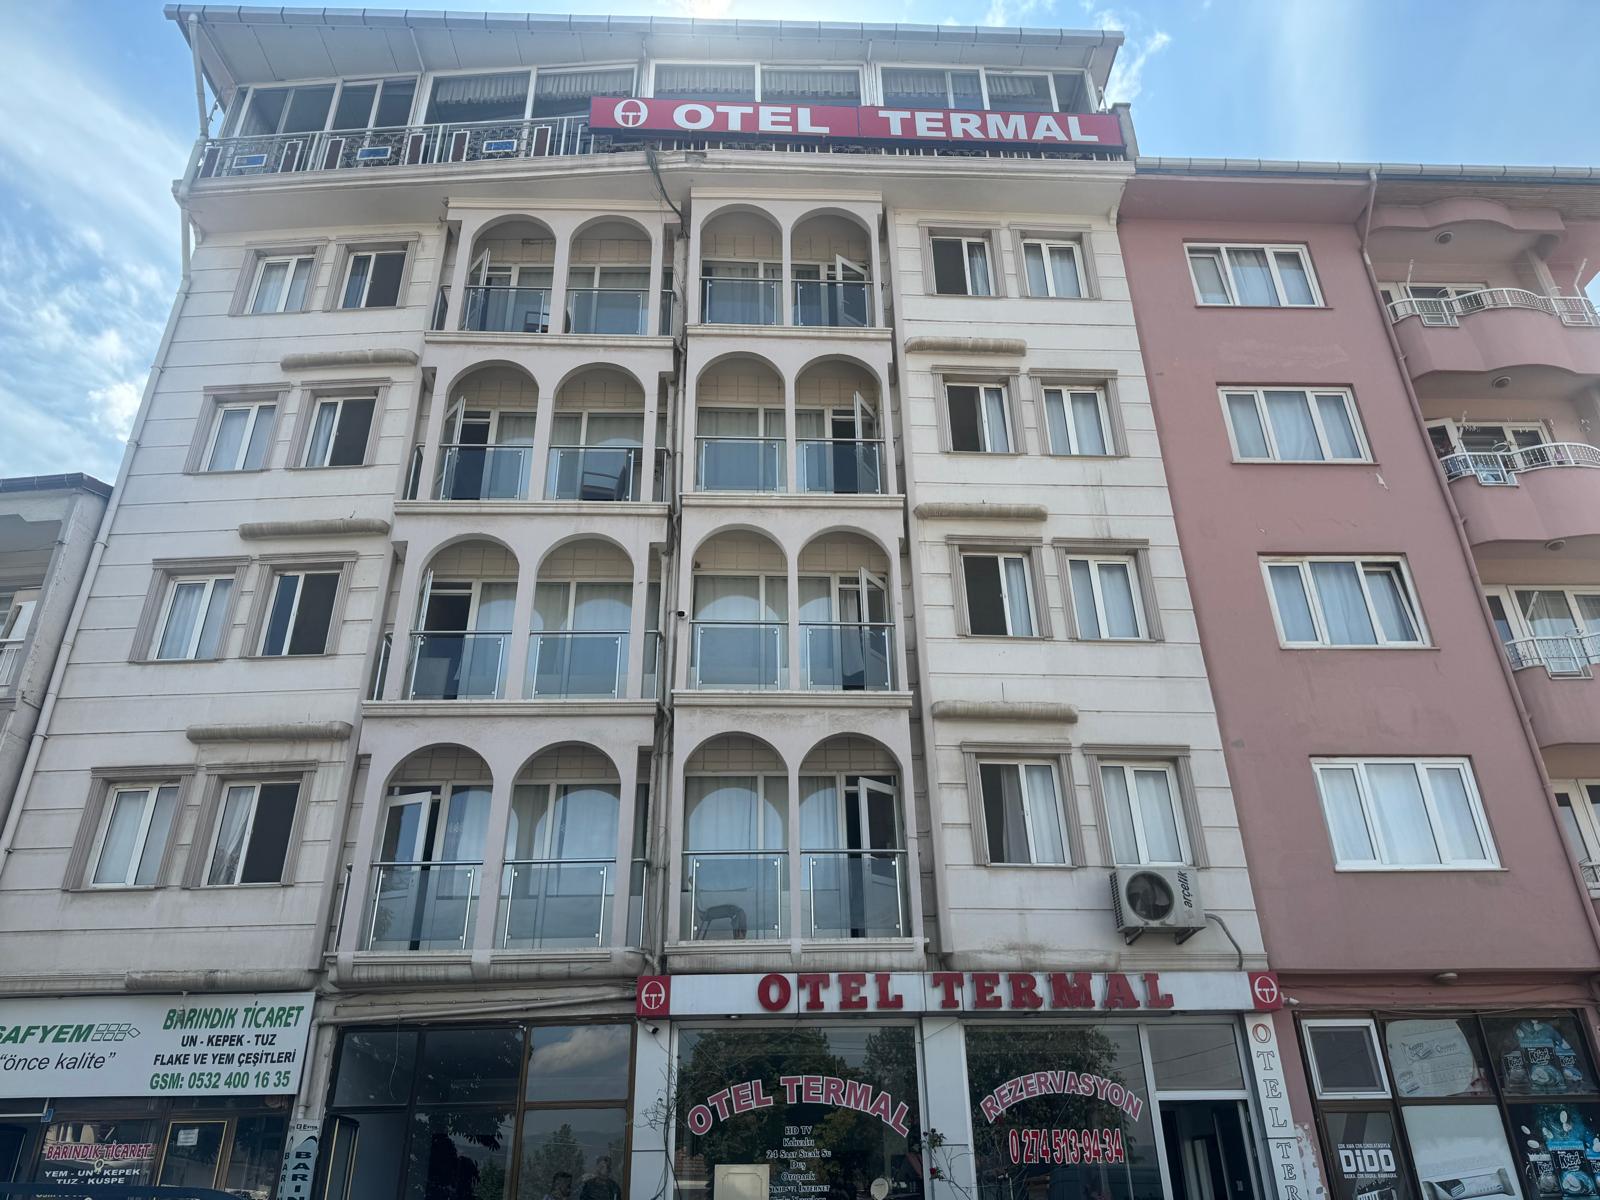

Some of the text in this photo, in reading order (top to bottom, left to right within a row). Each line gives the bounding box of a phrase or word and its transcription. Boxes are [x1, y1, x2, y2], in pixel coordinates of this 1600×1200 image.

[672, 103, 830, 134] OTEL
[879, 110, 1099, 143] TERMAL
[1177, 870, 1193, 908] arçelik
[757, 973, 903, 1011] OTEL
[933, 972, 1174, 1009] TERMAL
[163, 1001, 304, 1030] BARINDIK TİCARET
[181, 1035, 198, 1047] UN
[207, 1035, 245, 1047] KEPEK
[254, 1034, 277, 1046] TUZ
[153, 1049, 297, 1067] FLAKE VE YEM ÇEŞİTLERİ
[150, 1071, 291, 1090] GSM: 0532 400 16 35
[1252, 1023, 1287, 1128] OTEL
[688, 1075, 910, 1138] OTEL TERMAL
[980, 1070, 1143, 1123] REZERVASYON
[785, 1126, 813, 1135] HD TV
[45, 1140, 153, 1160] BARINDIK TİCARET
[766, 1150, 778, 1159] 24
[821, 1149, 832, 1157] Su
[1009, 1129, 1125, 1164] 0 274 513 94 34
[45, 1170, 68, 1178] YEM
[103, 1168, 141, 1176] KEPEK
